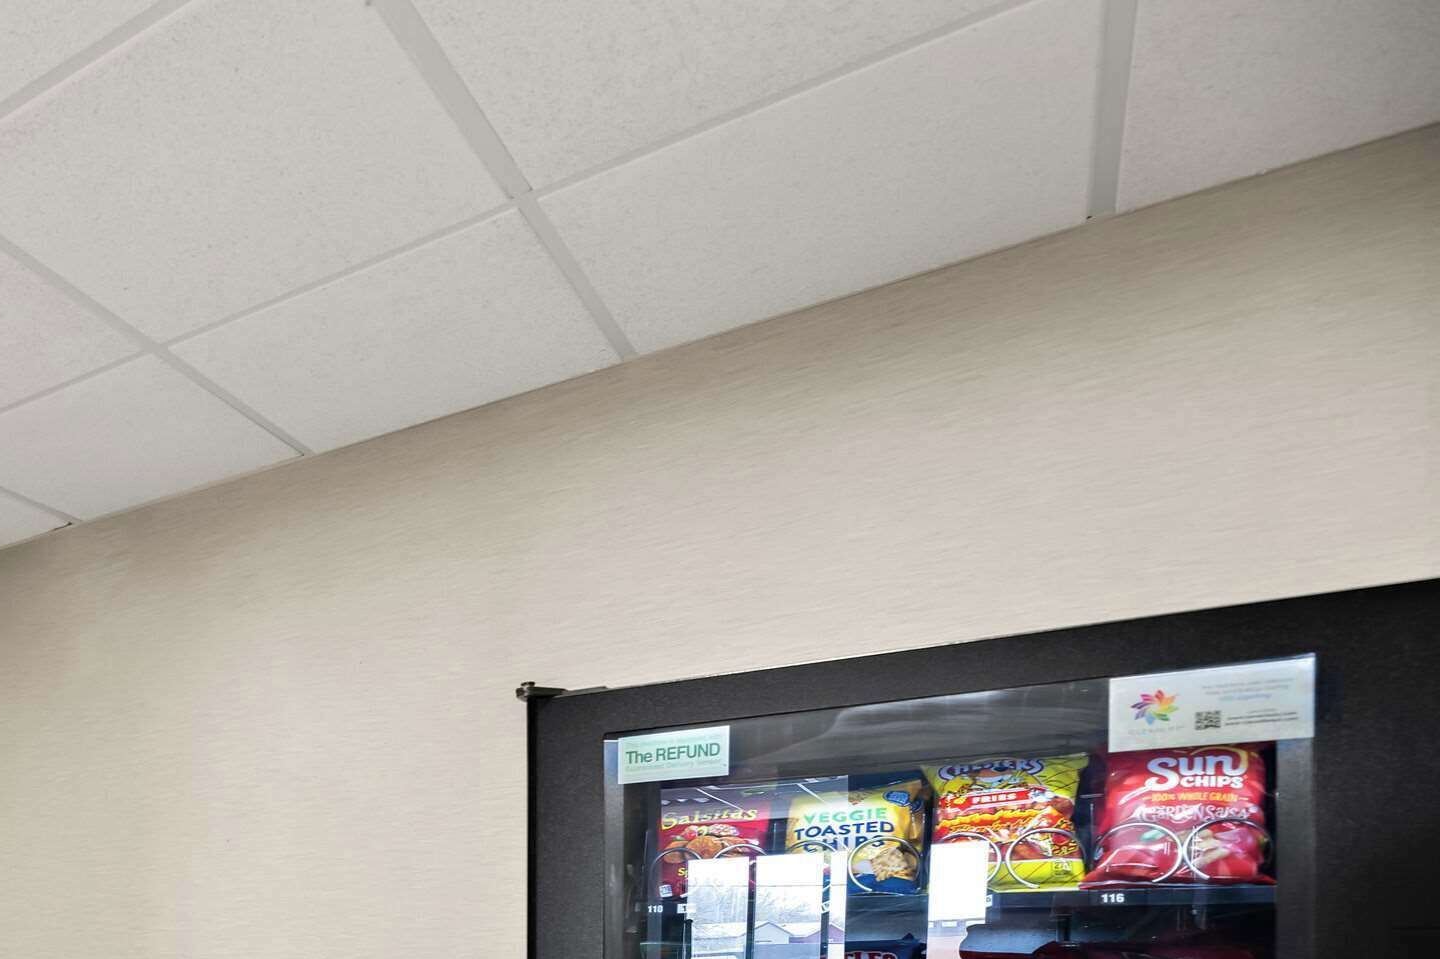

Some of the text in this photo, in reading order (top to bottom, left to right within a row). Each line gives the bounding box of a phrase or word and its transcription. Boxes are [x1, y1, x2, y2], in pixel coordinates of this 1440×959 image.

[626, 742, 720, 764] The REFUND
[1146, 755, 1249, 791] Sun
[1180, 775, 1244, 788] CHIPS
[971, 793, 1017, 804] FRIES
[803, 807, 888, 825] VEGGIE
[793, 821, 895, 841] TOASTED
[1101, 893, 1125, 903] 116
